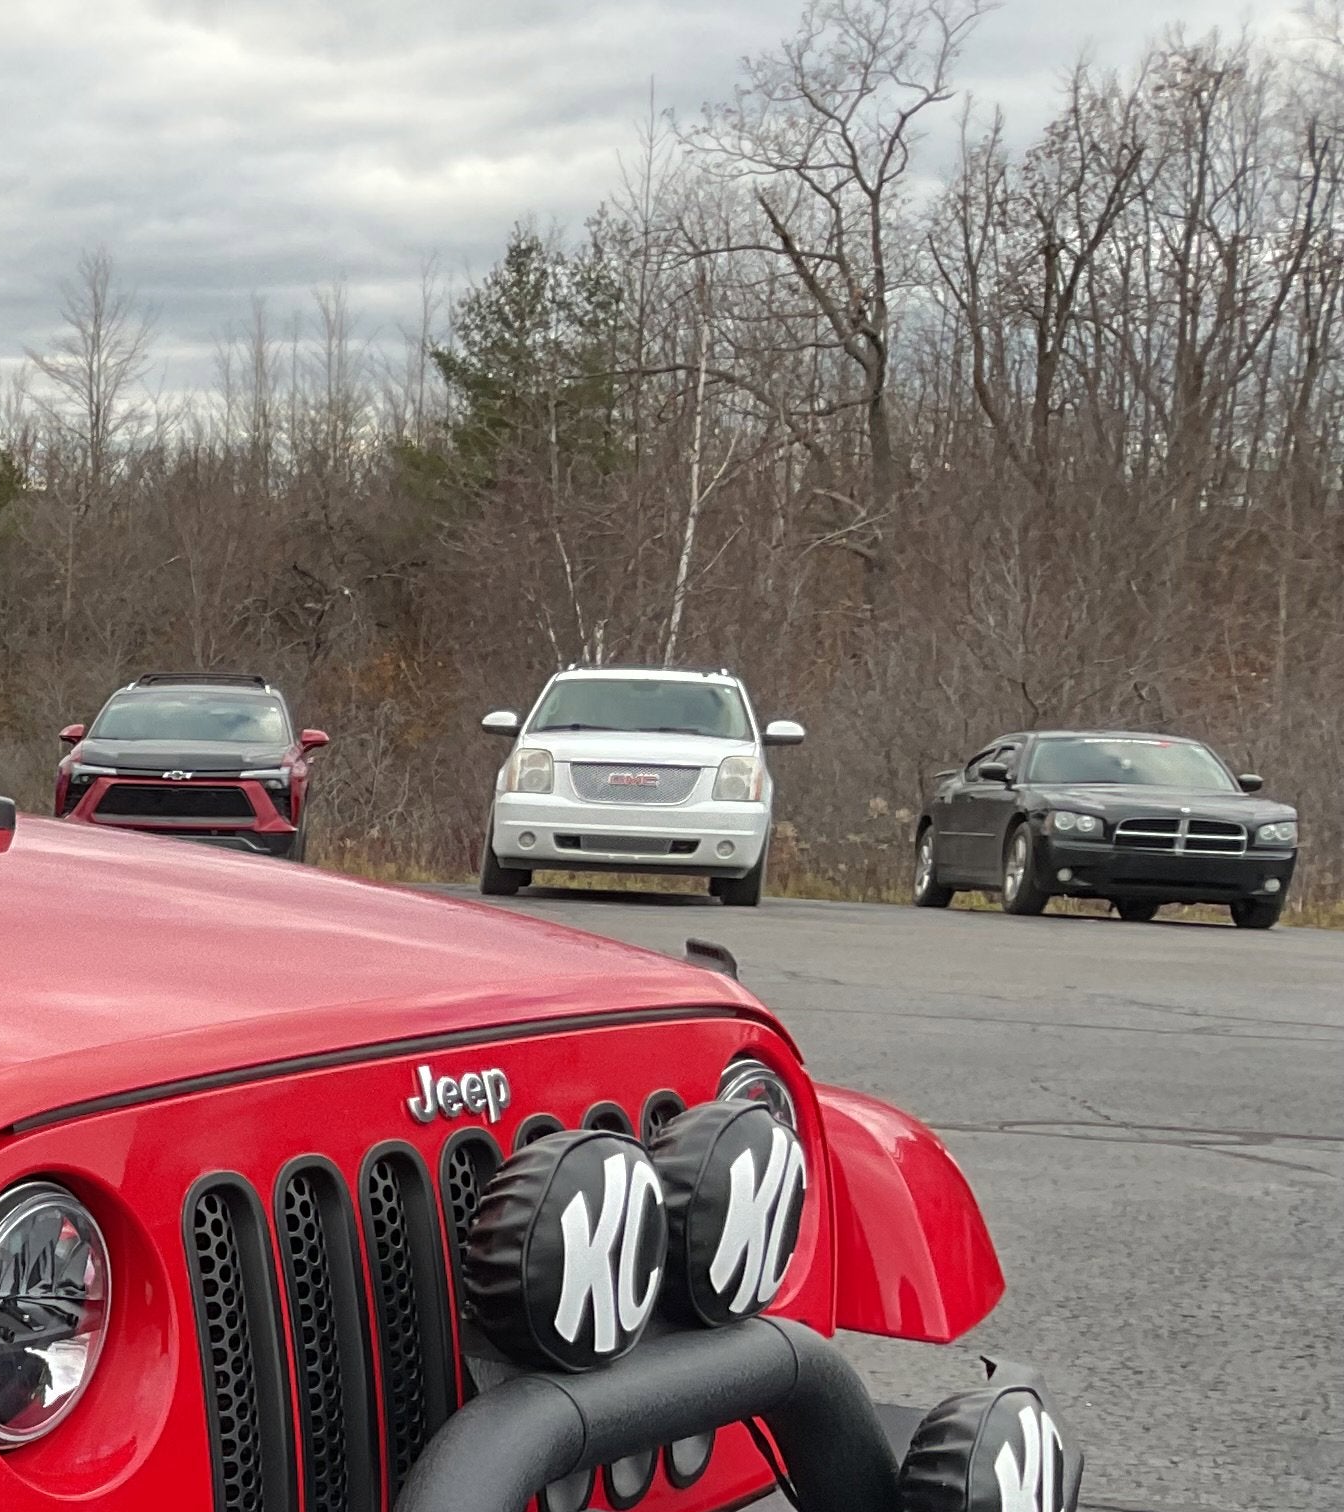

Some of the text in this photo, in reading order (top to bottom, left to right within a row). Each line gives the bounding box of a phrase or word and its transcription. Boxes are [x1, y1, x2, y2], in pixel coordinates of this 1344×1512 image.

[407, 1064, 511, 1124] Jeep
[554, 1152, 663, 1353] KC
[709, 1126, 808, 1314] KC
